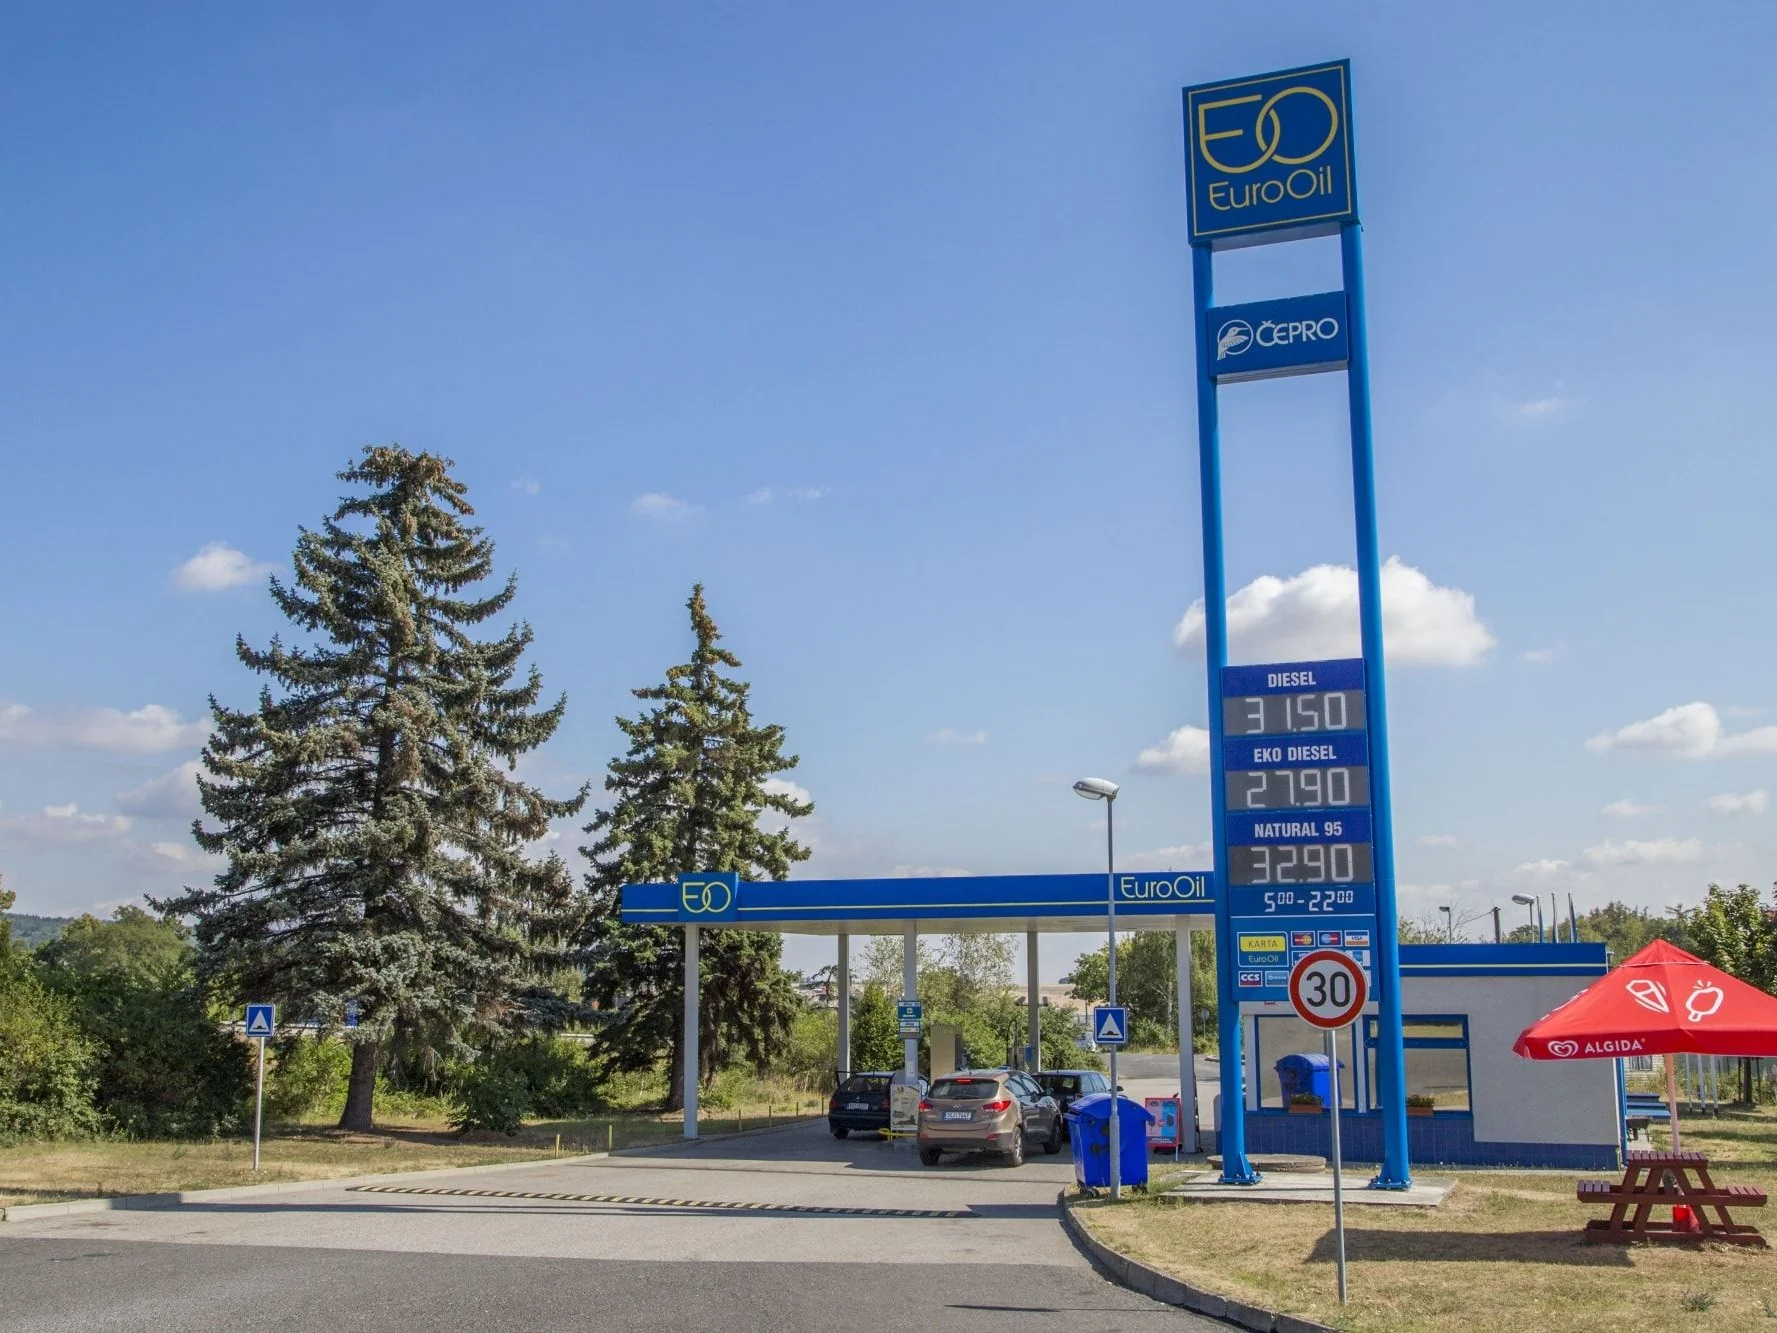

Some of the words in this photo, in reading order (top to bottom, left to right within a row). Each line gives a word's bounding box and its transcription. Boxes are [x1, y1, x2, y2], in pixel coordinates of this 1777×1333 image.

[1209, 165, 1332, 211] EuroOil
[1255, 317, 1339, 347] ČEPRO
[1267, 671, 1317, 687] DIESEL
[1253, 747, 1282, 762] EKO
[1287, 745, 1337, 760] DIESEL
[1246, 767, 1351, 808] 27.90
[1254, 822, 1319, 838] NATURAL
[1324, 821, 1343, 837] 95
[1250, 844, 1354, 884] 32.90
[1120, 875, 1206, 900] EuroOil
[1248, 939, 1278, 948] KARTA
[1248, 955, 1279, 963] EuroOil
[1306, 971, 1350, 1007] 30
[1585, 1040, 1643, 1054] ALGIDA
